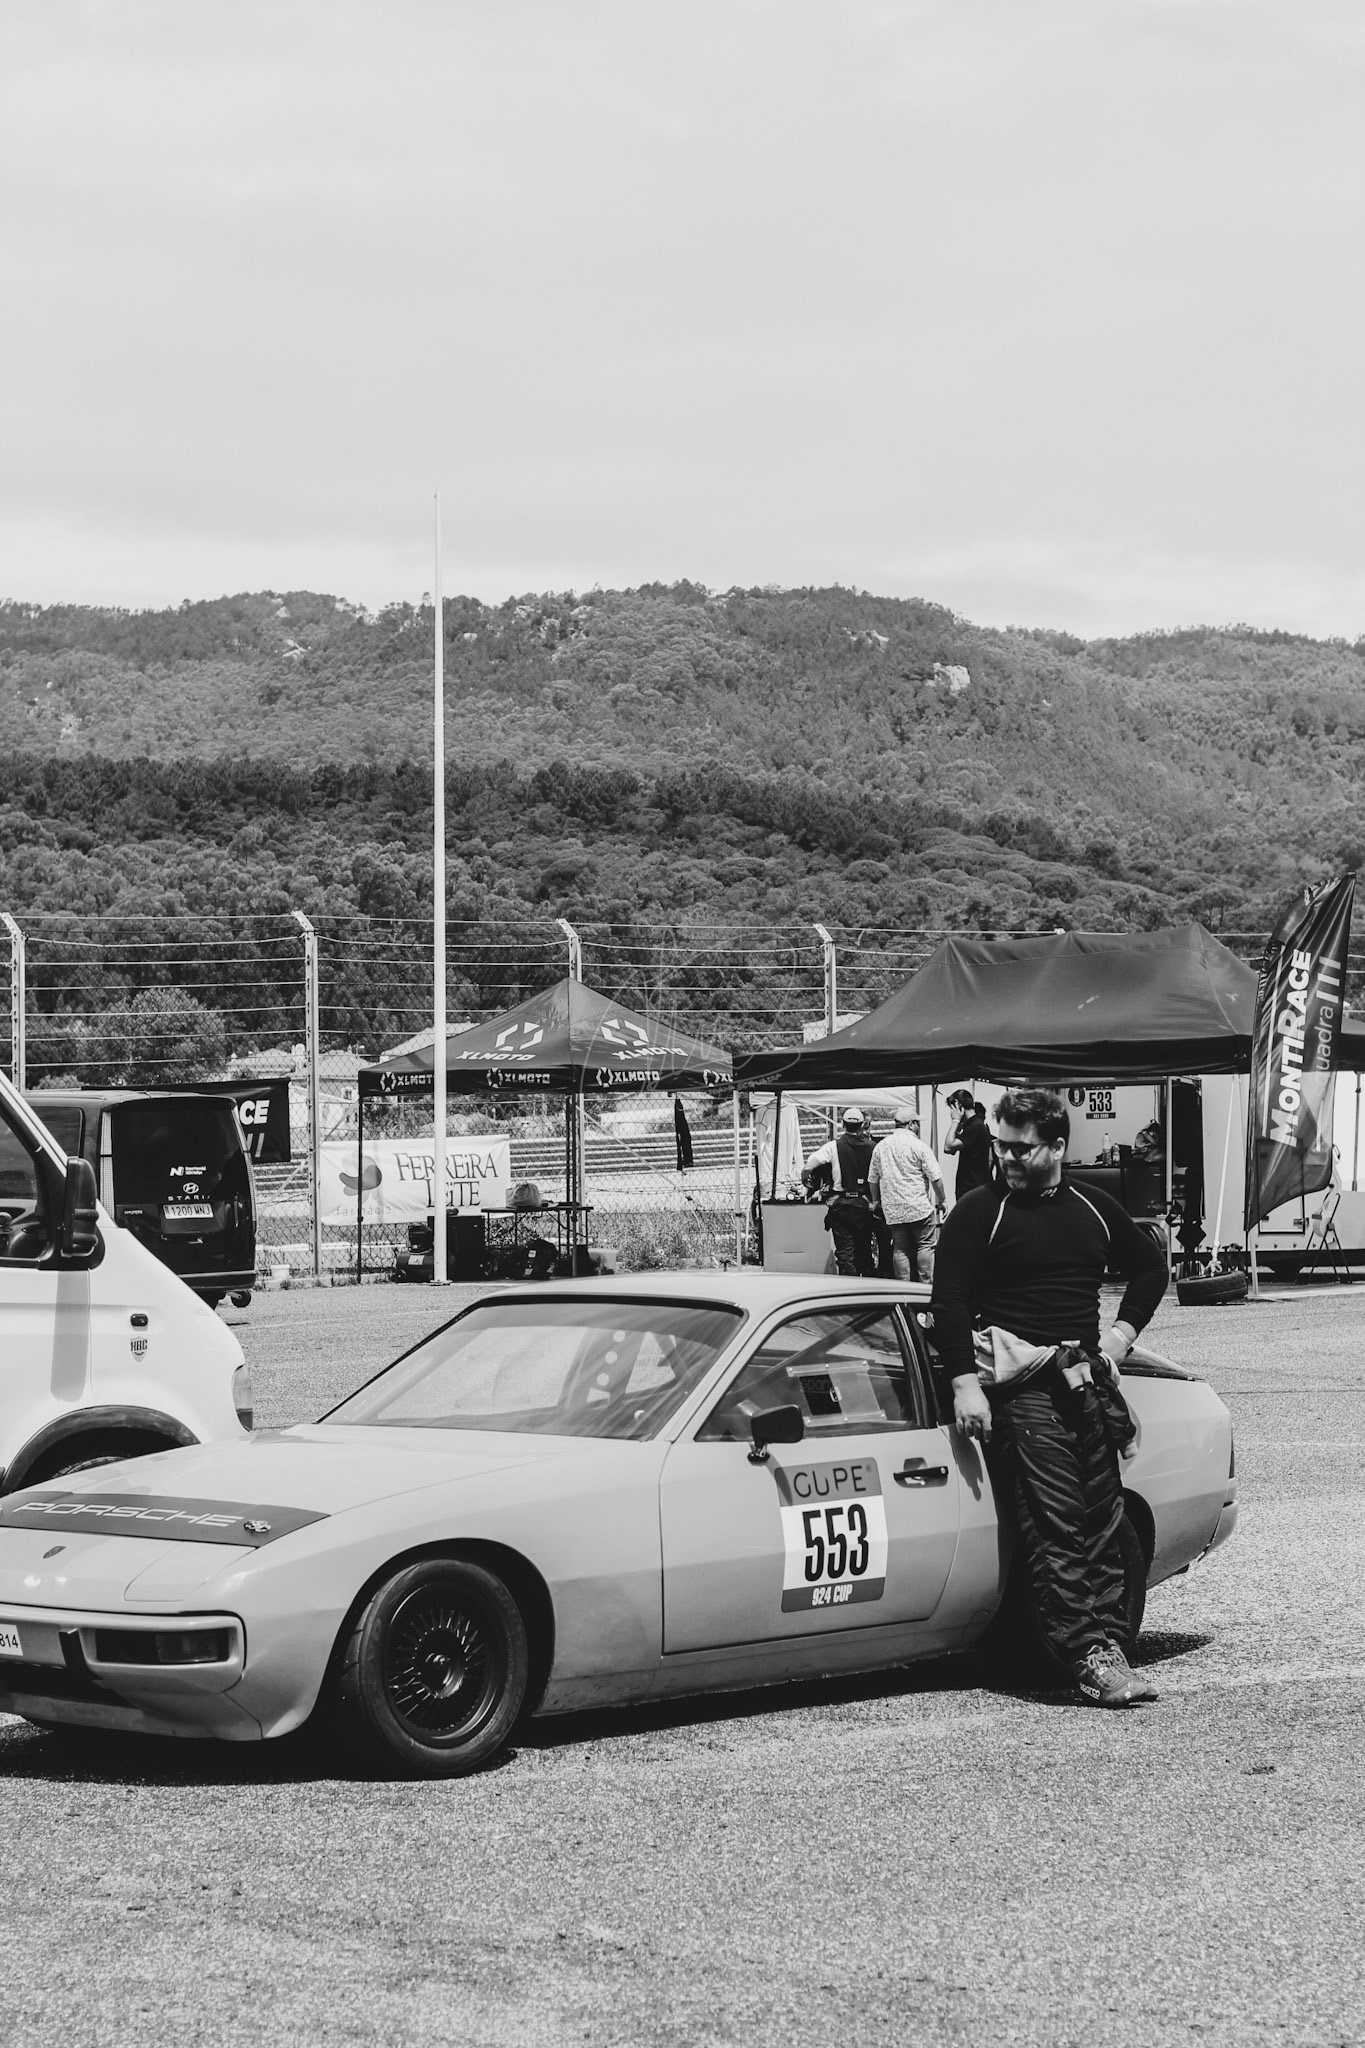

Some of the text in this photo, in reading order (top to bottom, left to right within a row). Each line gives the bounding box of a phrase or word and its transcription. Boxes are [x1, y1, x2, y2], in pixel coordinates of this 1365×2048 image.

[455, 1051, 537, 1061] XLMOTO
[612, 1047, 689, 1061] XLMOTO
[397, 1073, 435, 1086] XLMOT
[504, 1073, 551, 1084] XLMOTO
[613, 1071, 661, 1082] XLMOTO
[1089, 1091, 1113, 1112] 533
[171, 1205, 193, 1217] 1200
[12, 1501, 245, 1528] PORSCHE
[802, 1503, 870, 1582] 553
[811, 1583, 853, 1606] 924 CUP
